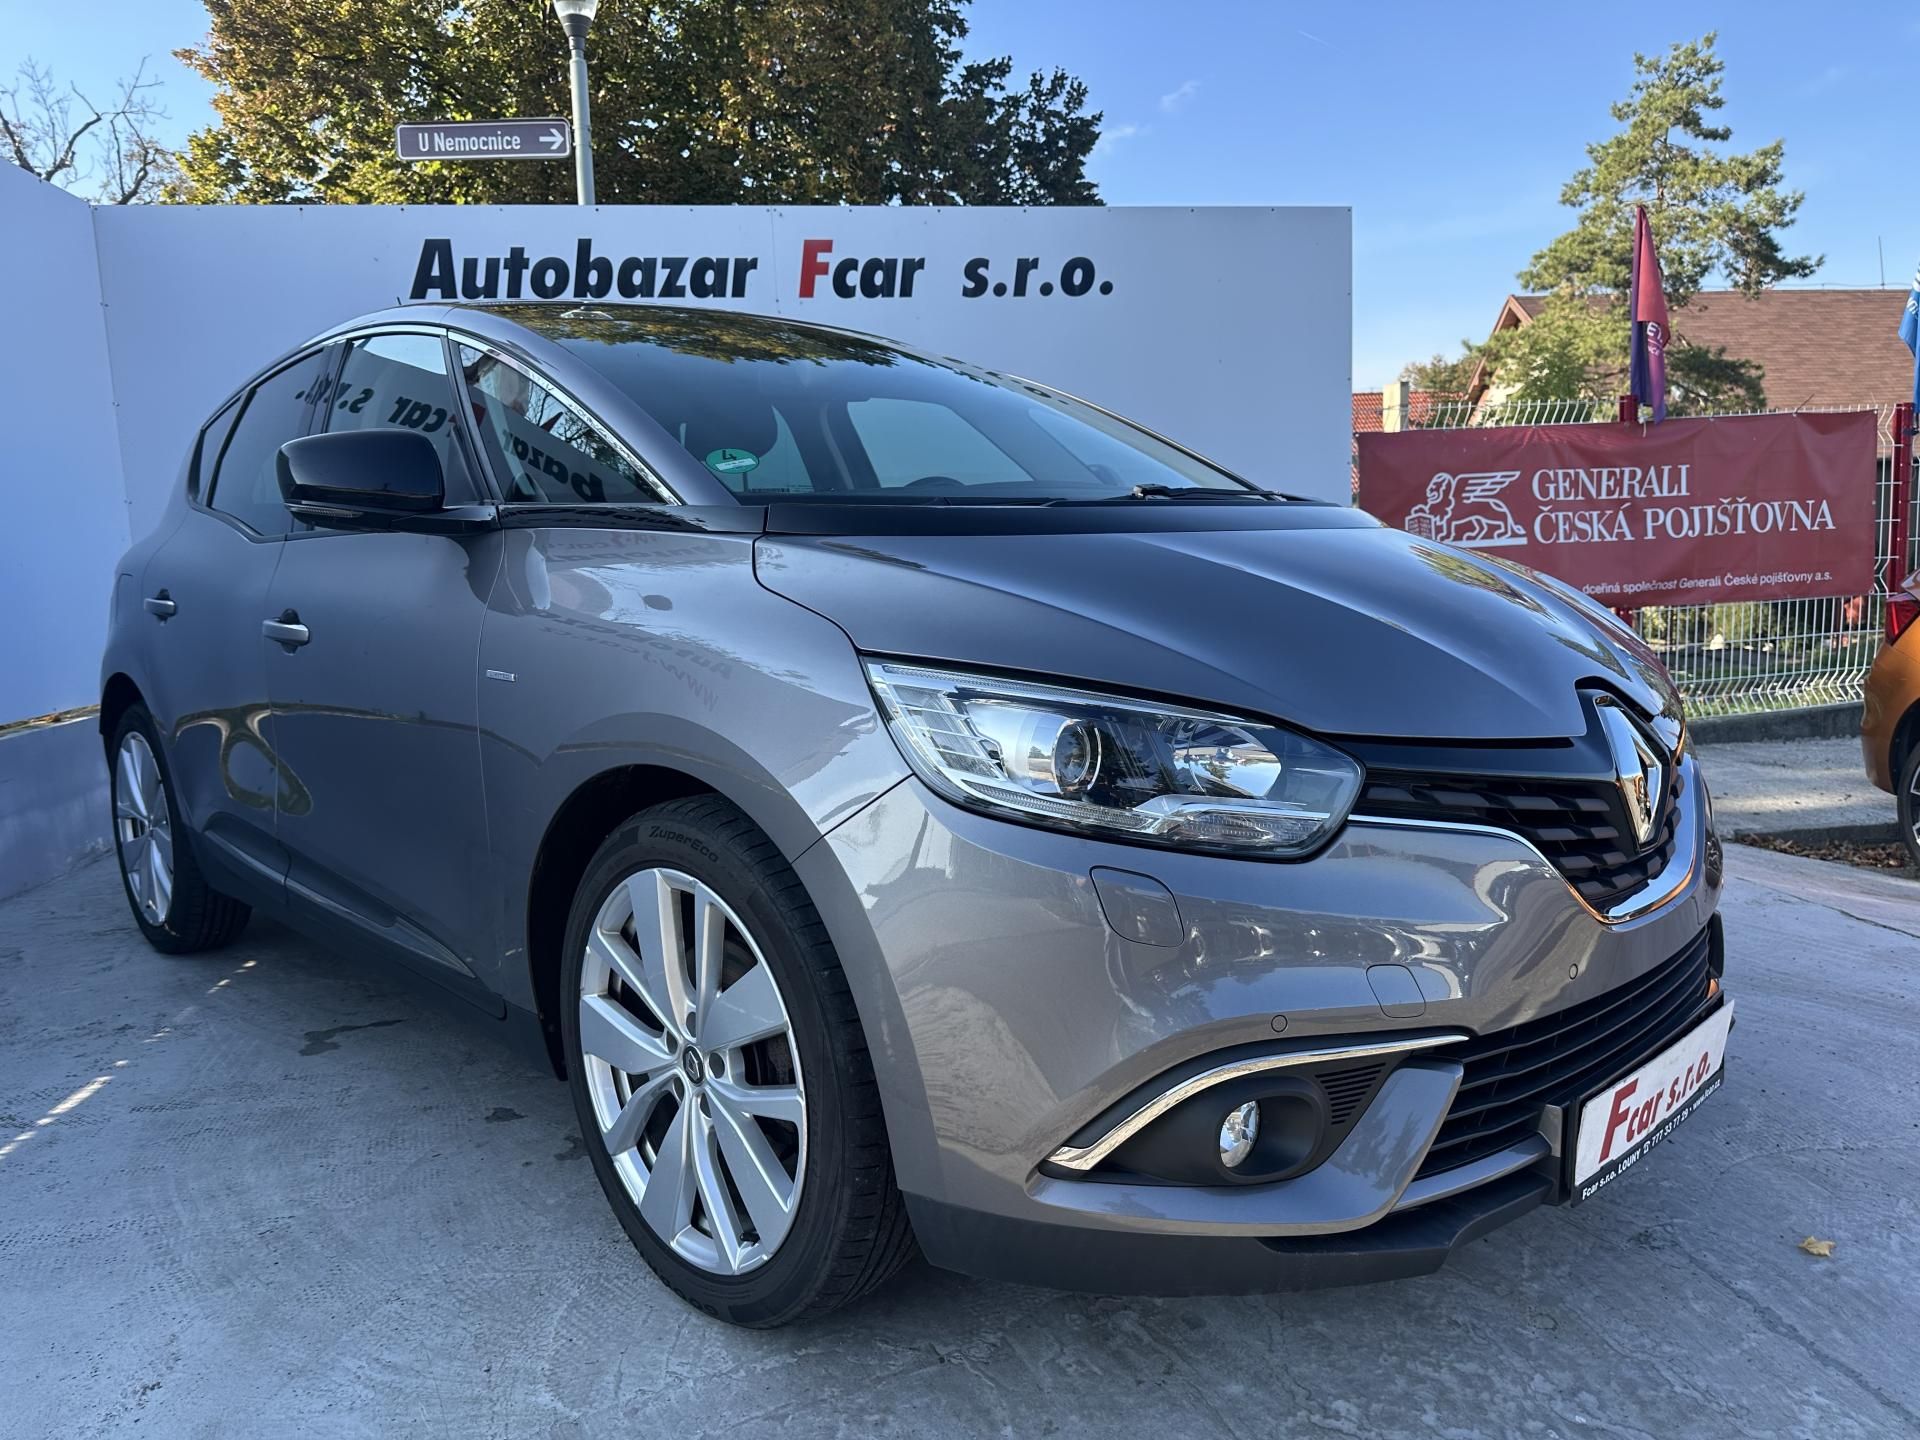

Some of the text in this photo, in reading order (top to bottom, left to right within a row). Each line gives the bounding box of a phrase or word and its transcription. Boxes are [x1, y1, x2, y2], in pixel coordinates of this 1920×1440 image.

[418, 131, 521, 151] U Nemocnice
[409, 238, 1113, 299] Autobazar Fcar s.r.o.
[1532, 464, 1690, 502] GENERALI
[1533, 496, 1836, 544] ČESKÁ POJIŠŤOVNA
[1582, 571, 1833, 595] dceřiná společnost Generali České pojišťovny a.s.
[649, 826, 719, 863] ZuperEco
[1598, 1051, 1711, 1163] Fcar s.r.o.
[1582, 1182, 1598, 1200] Fcar
[1600, 1171, 1617, 1187] s.r.o.
[1618, 1148, 1640, 1174] LOUNY
[1651, 1129, 1663, 1147] 777
[1673, 1114, 1680, 1129] 77
